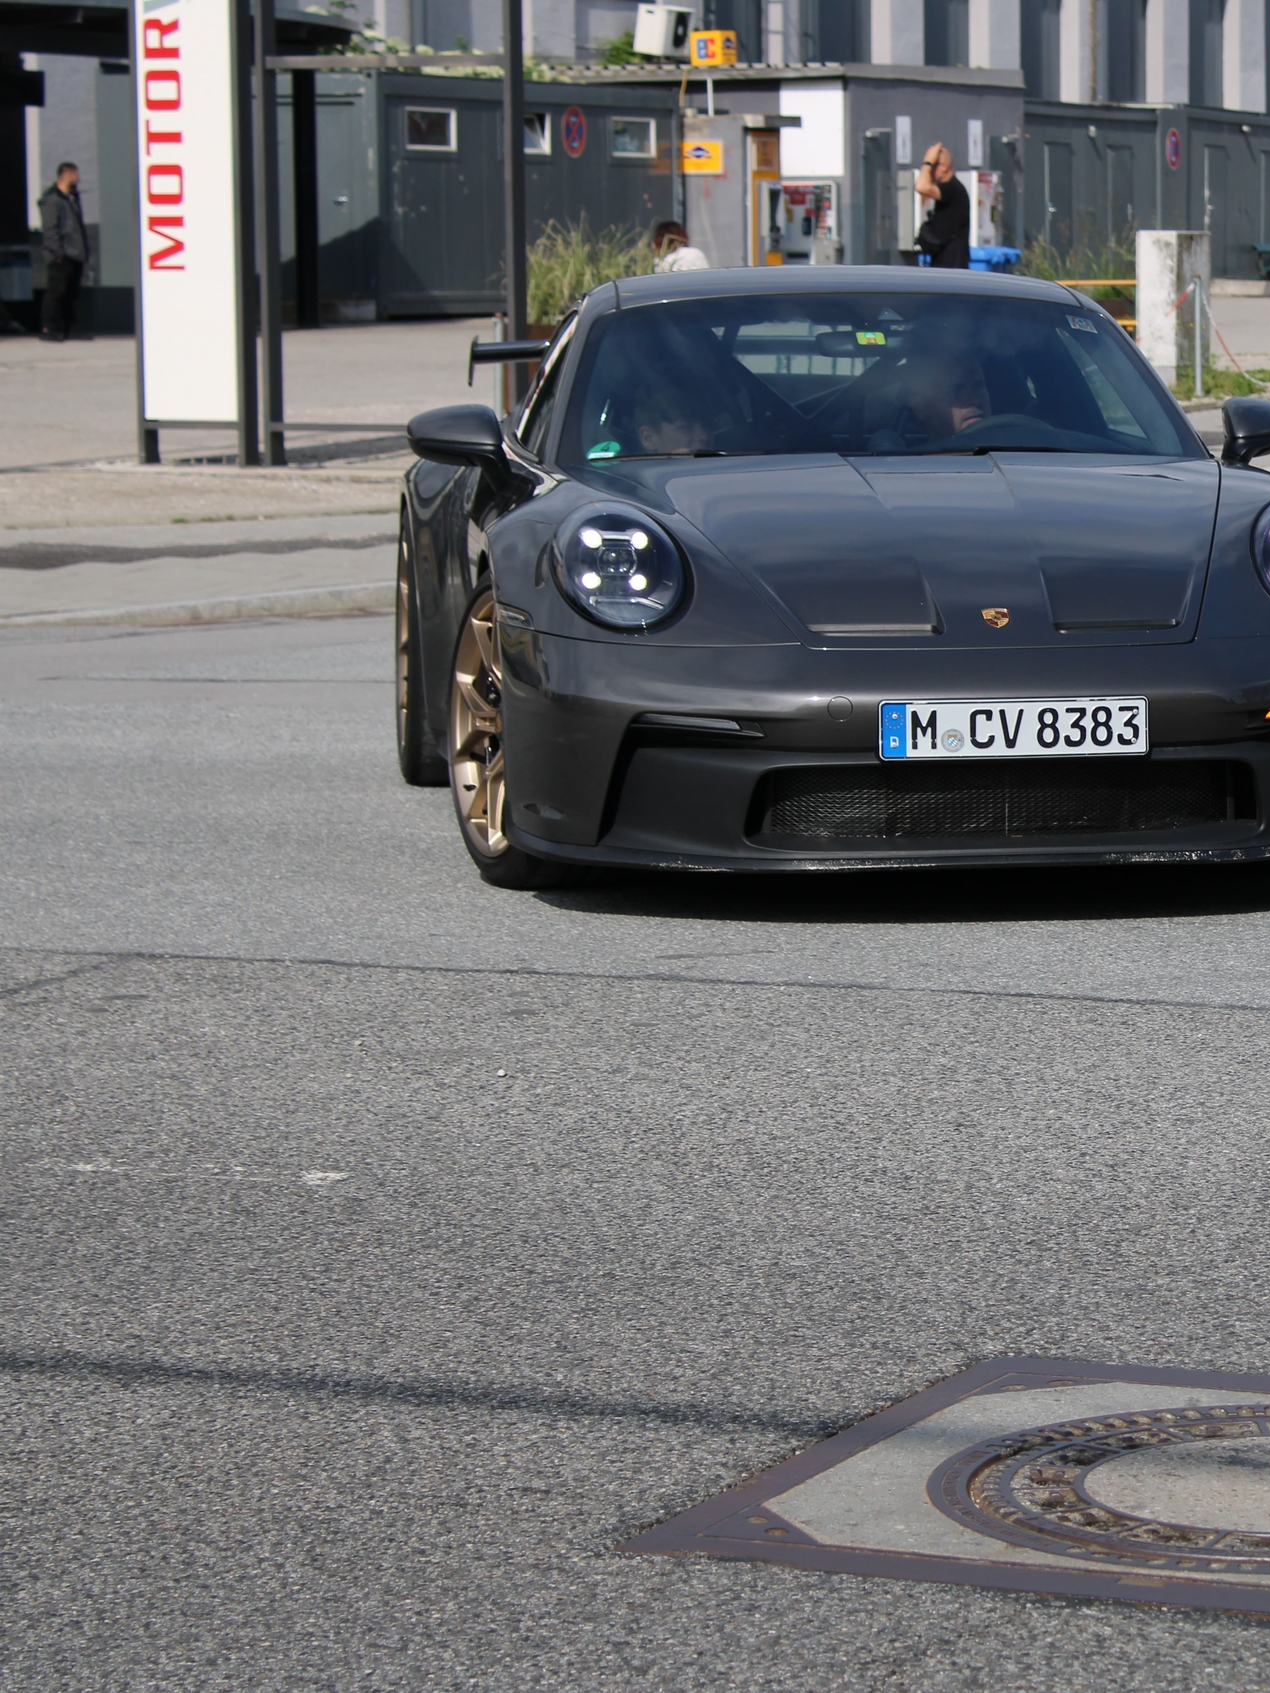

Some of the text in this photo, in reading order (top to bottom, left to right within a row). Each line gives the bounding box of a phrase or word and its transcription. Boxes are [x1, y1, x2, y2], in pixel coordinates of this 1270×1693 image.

[144, 18, 185, 270] MOTOR
[911, 706, 1140, 749] M CV 8383
